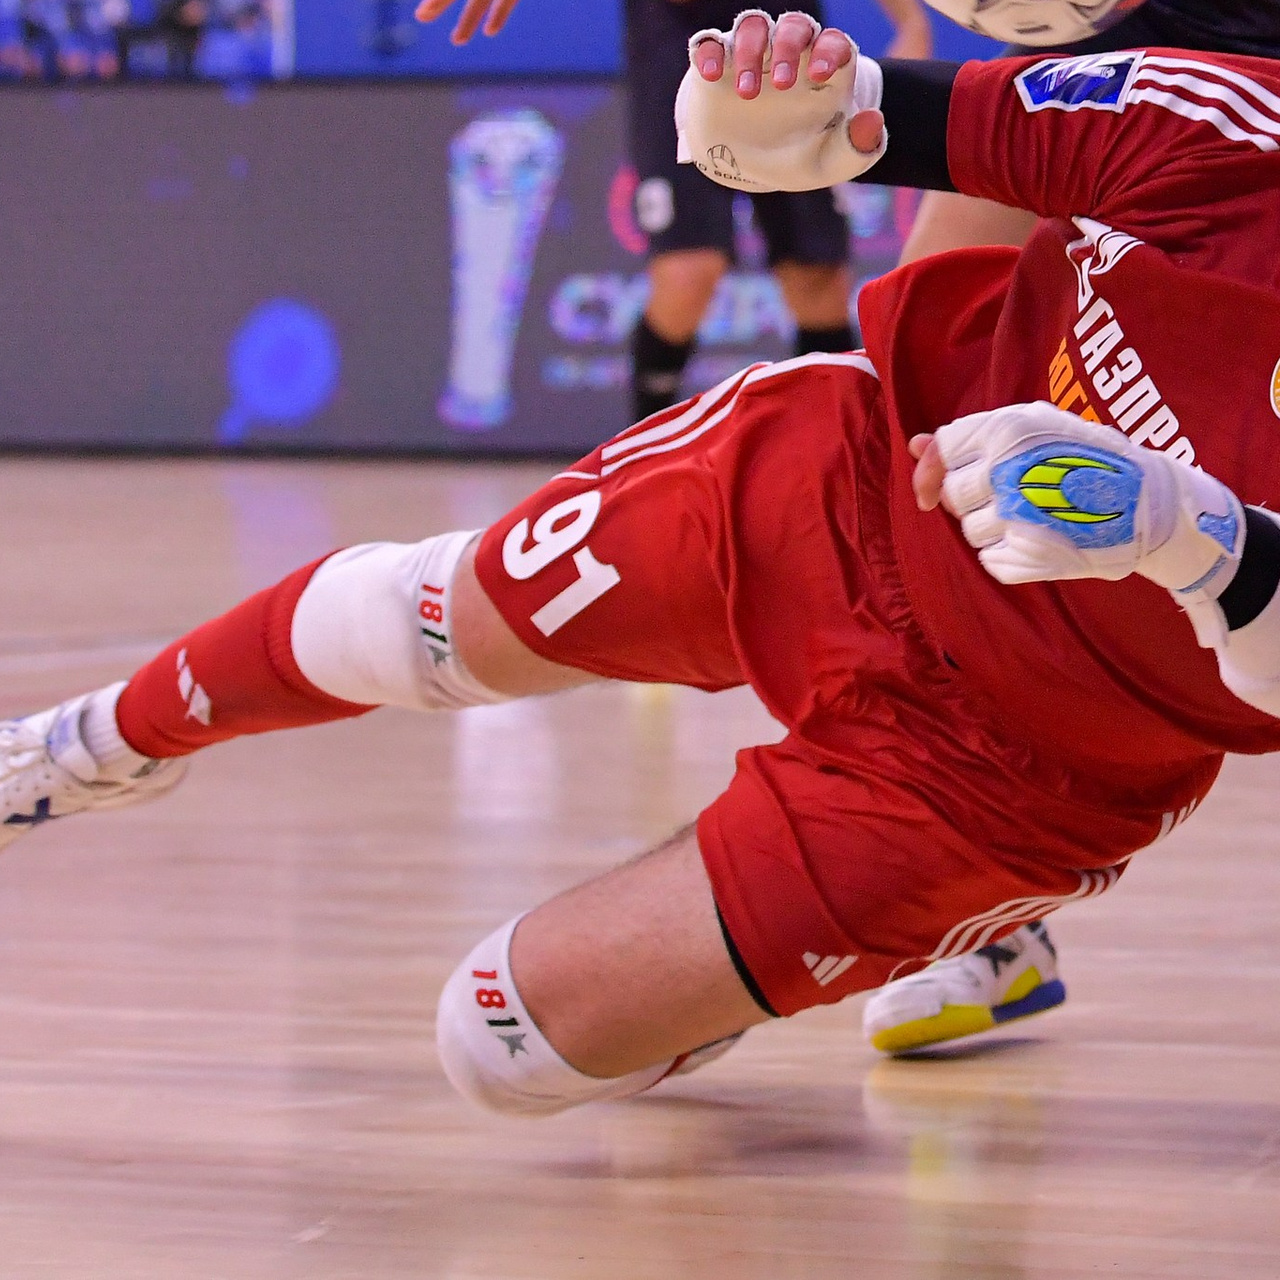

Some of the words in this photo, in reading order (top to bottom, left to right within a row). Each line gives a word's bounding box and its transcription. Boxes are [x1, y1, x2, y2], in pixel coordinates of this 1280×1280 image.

[1049, 337, 1101, 424] ЮГ
[1073, 297, 1203, 473] ГАЗПР
[502, 490, 621, 637] 91
